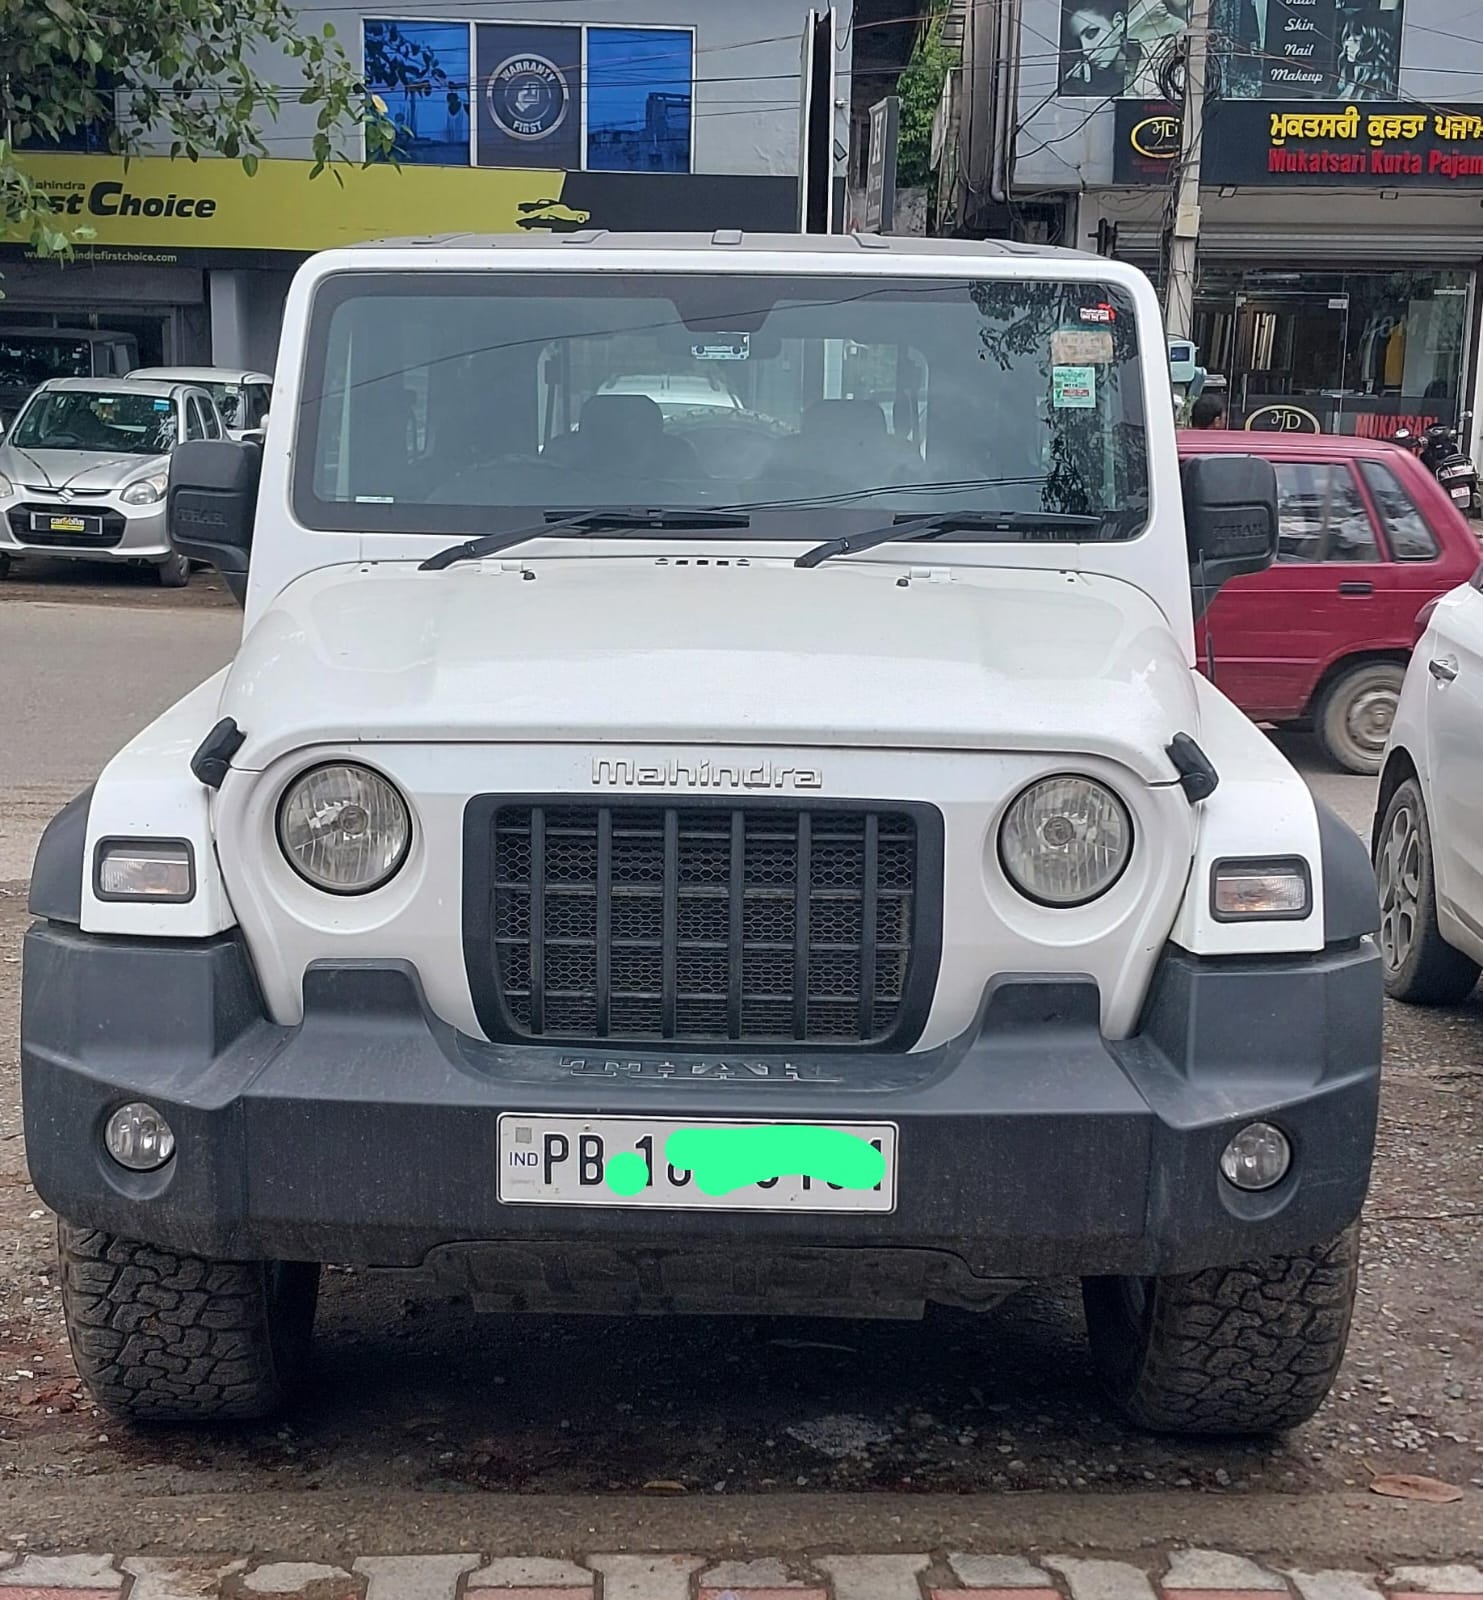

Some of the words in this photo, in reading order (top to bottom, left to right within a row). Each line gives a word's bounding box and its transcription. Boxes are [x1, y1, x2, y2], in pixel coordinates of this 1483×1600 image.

[1284, 18, 1315, 32] Skin
[1284, 43, 1314, 56] Nail
[500, 61, 556, 82] WARRANTY
[1270, 68, 1323, 85] Makeup
[513, 120, 542, 133] FIRST
[1268, 148, 1367, 173] Mukatsari
[1371, 149, 1423, 174] Kurta
[29, 180, 86, 191] ahindra
[87, 181, 217, 218] Choice
[592, 757, 823, 789] Mahindra
[509, 1151, 539, 1167] IND
[543, 1132, 605, 1186] PB
